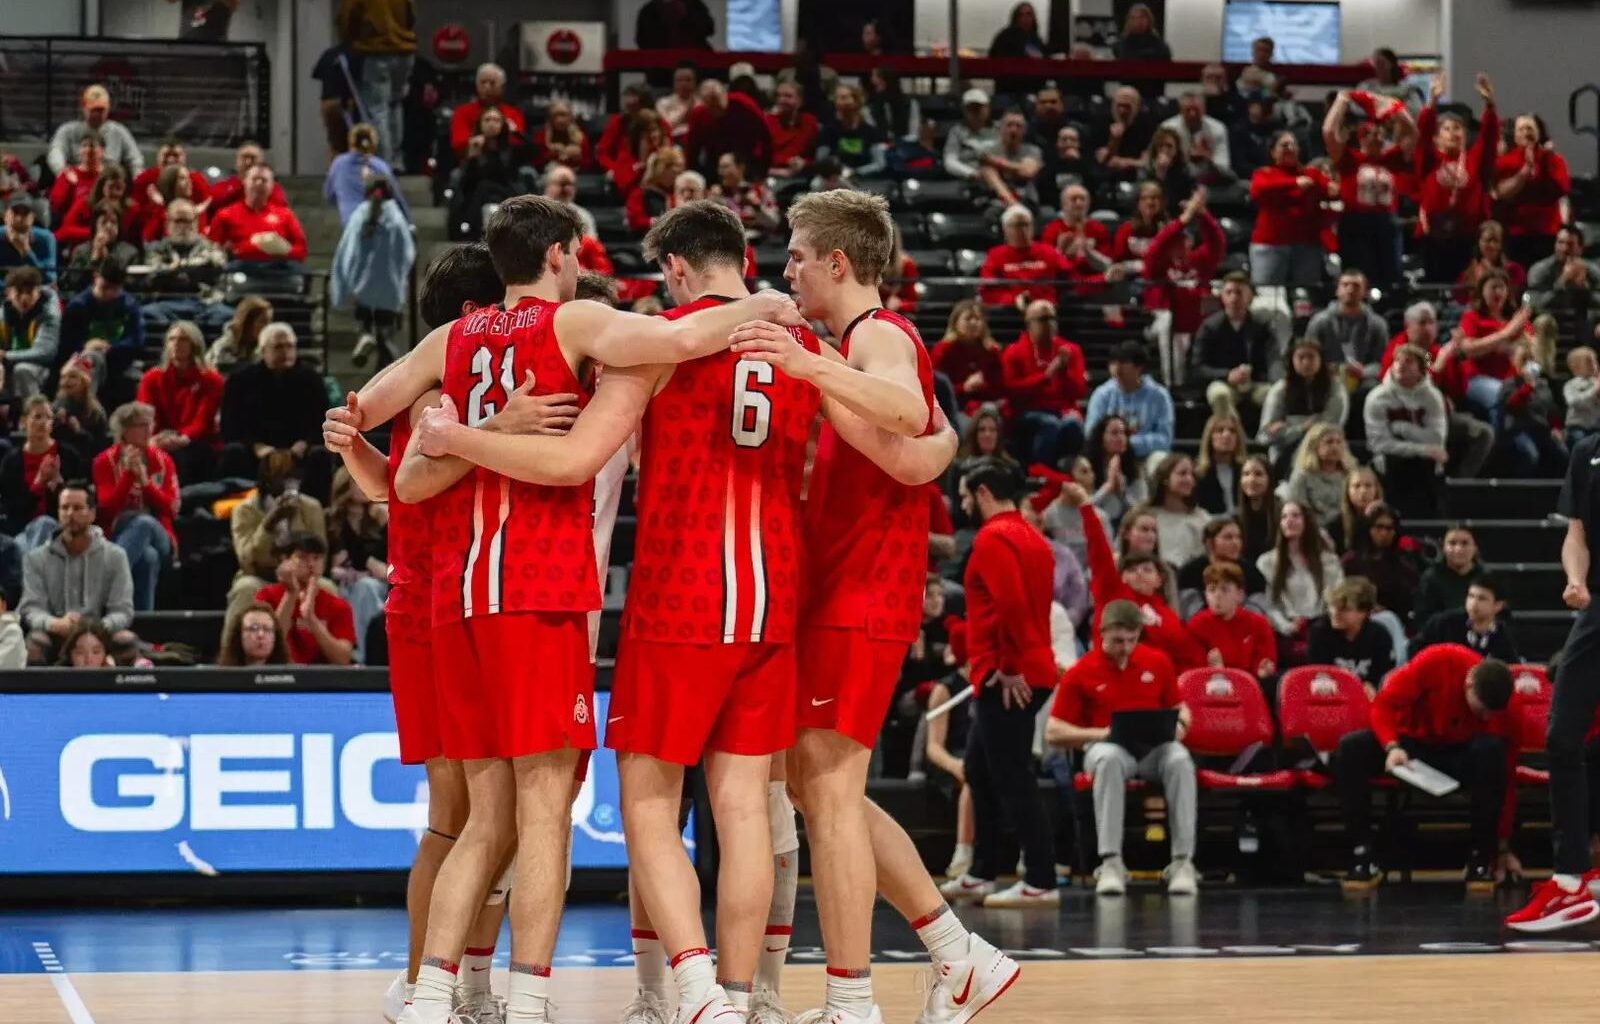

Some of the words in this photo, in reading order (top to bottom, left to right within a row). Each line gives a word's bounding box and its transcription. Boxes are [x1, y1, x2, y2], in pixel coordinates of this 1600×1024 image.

[467, 344, 516, 428] 21
[731, 358, 774, 448] 6
[59, 732, 595, 832] GEIC
